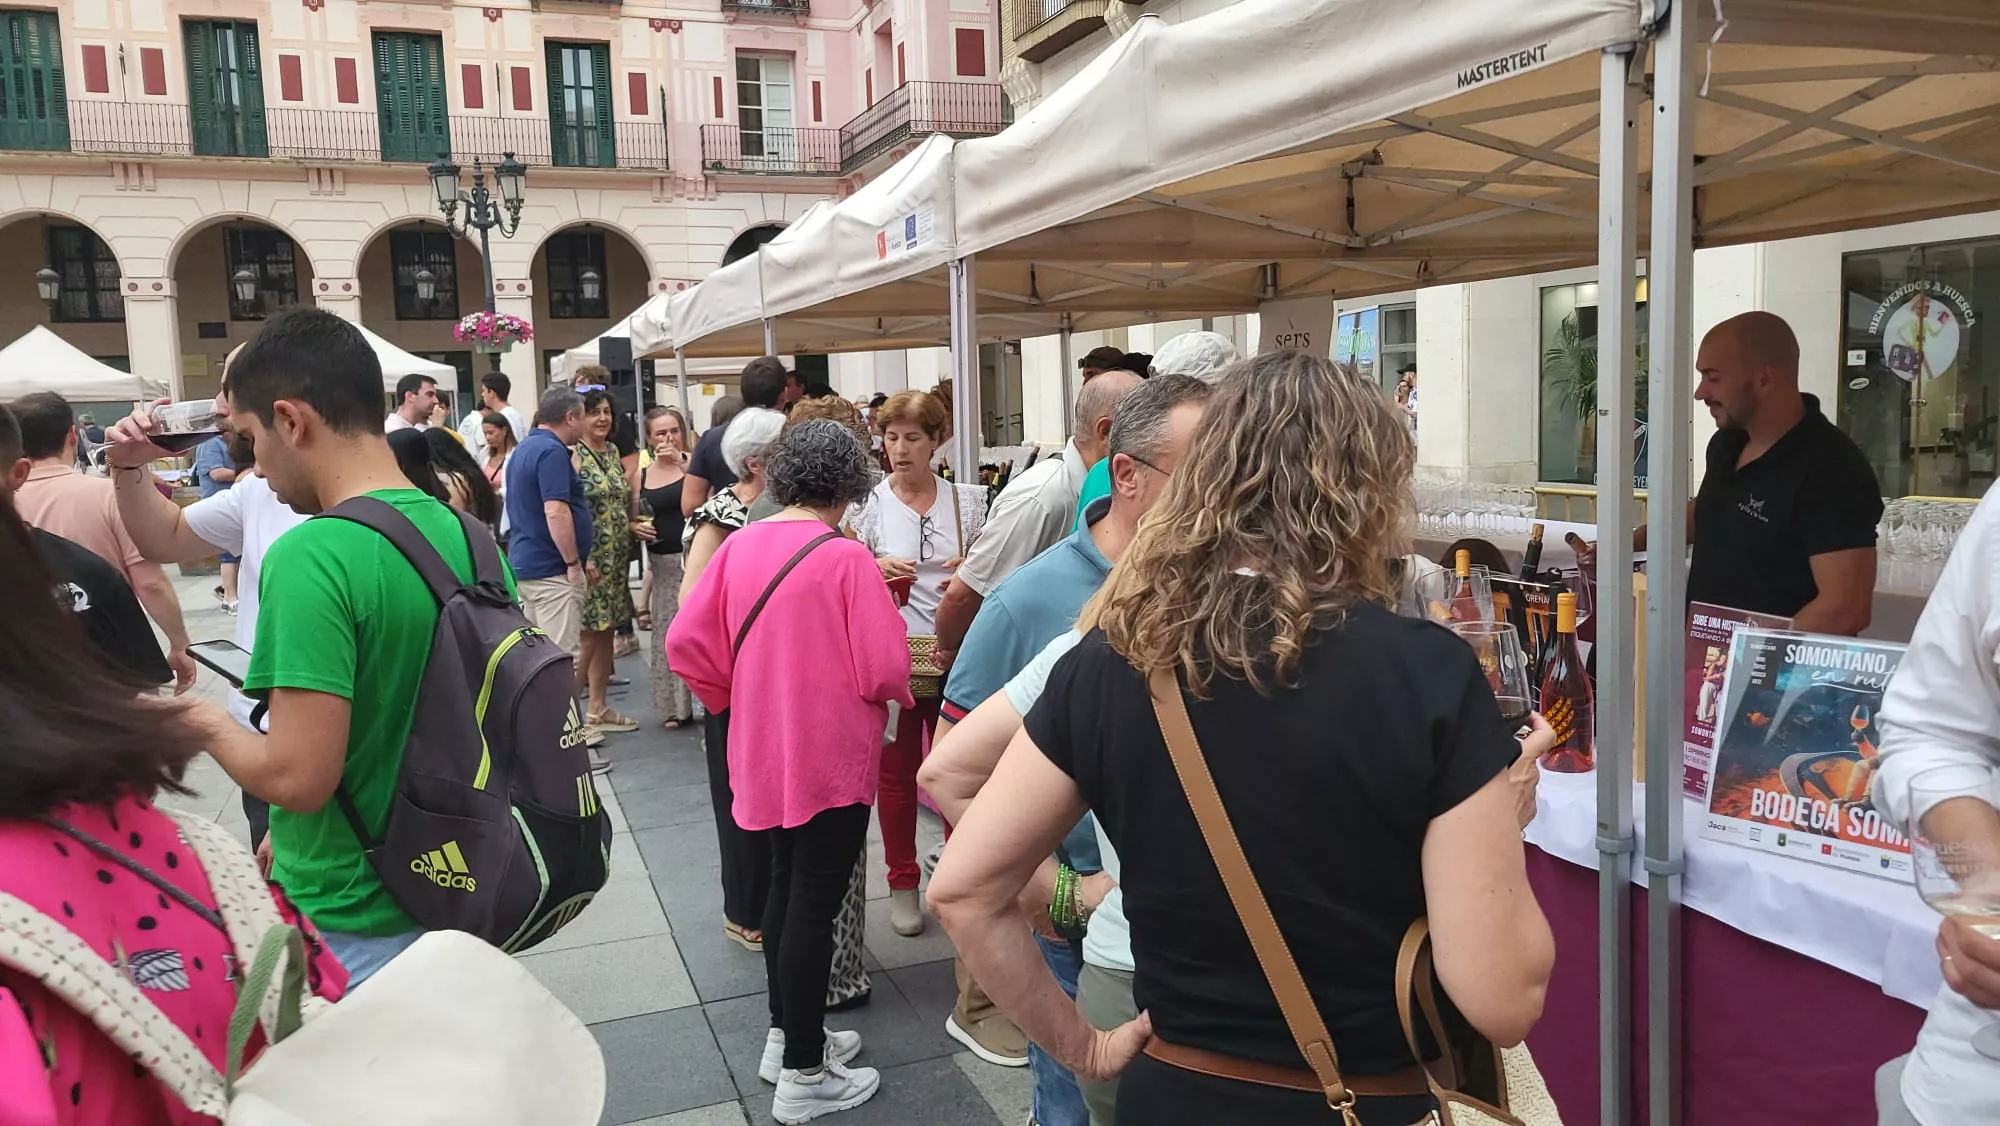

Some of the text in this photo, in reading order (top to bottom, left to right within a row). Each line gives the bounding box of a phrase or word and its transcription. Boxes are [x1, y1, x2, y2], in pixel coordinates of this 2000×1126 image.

[1457, 43, 1548, 88] MASTERTENT
[1868, 280, 1976, 335] BIENVENIDOS A HUESCA
[1692, 613, 1708, 627] SUBE
[1708, 616, 1721, 629] UNA
[1784, 643, 1887, 675] SOMONTANO
[1811, 663, 1896, 692] en rut
[558, 727, 588, 750] adidas
[1751, 788, 1910, 849] BODEGA SOM
[410, 858, 477, 893] adidas
